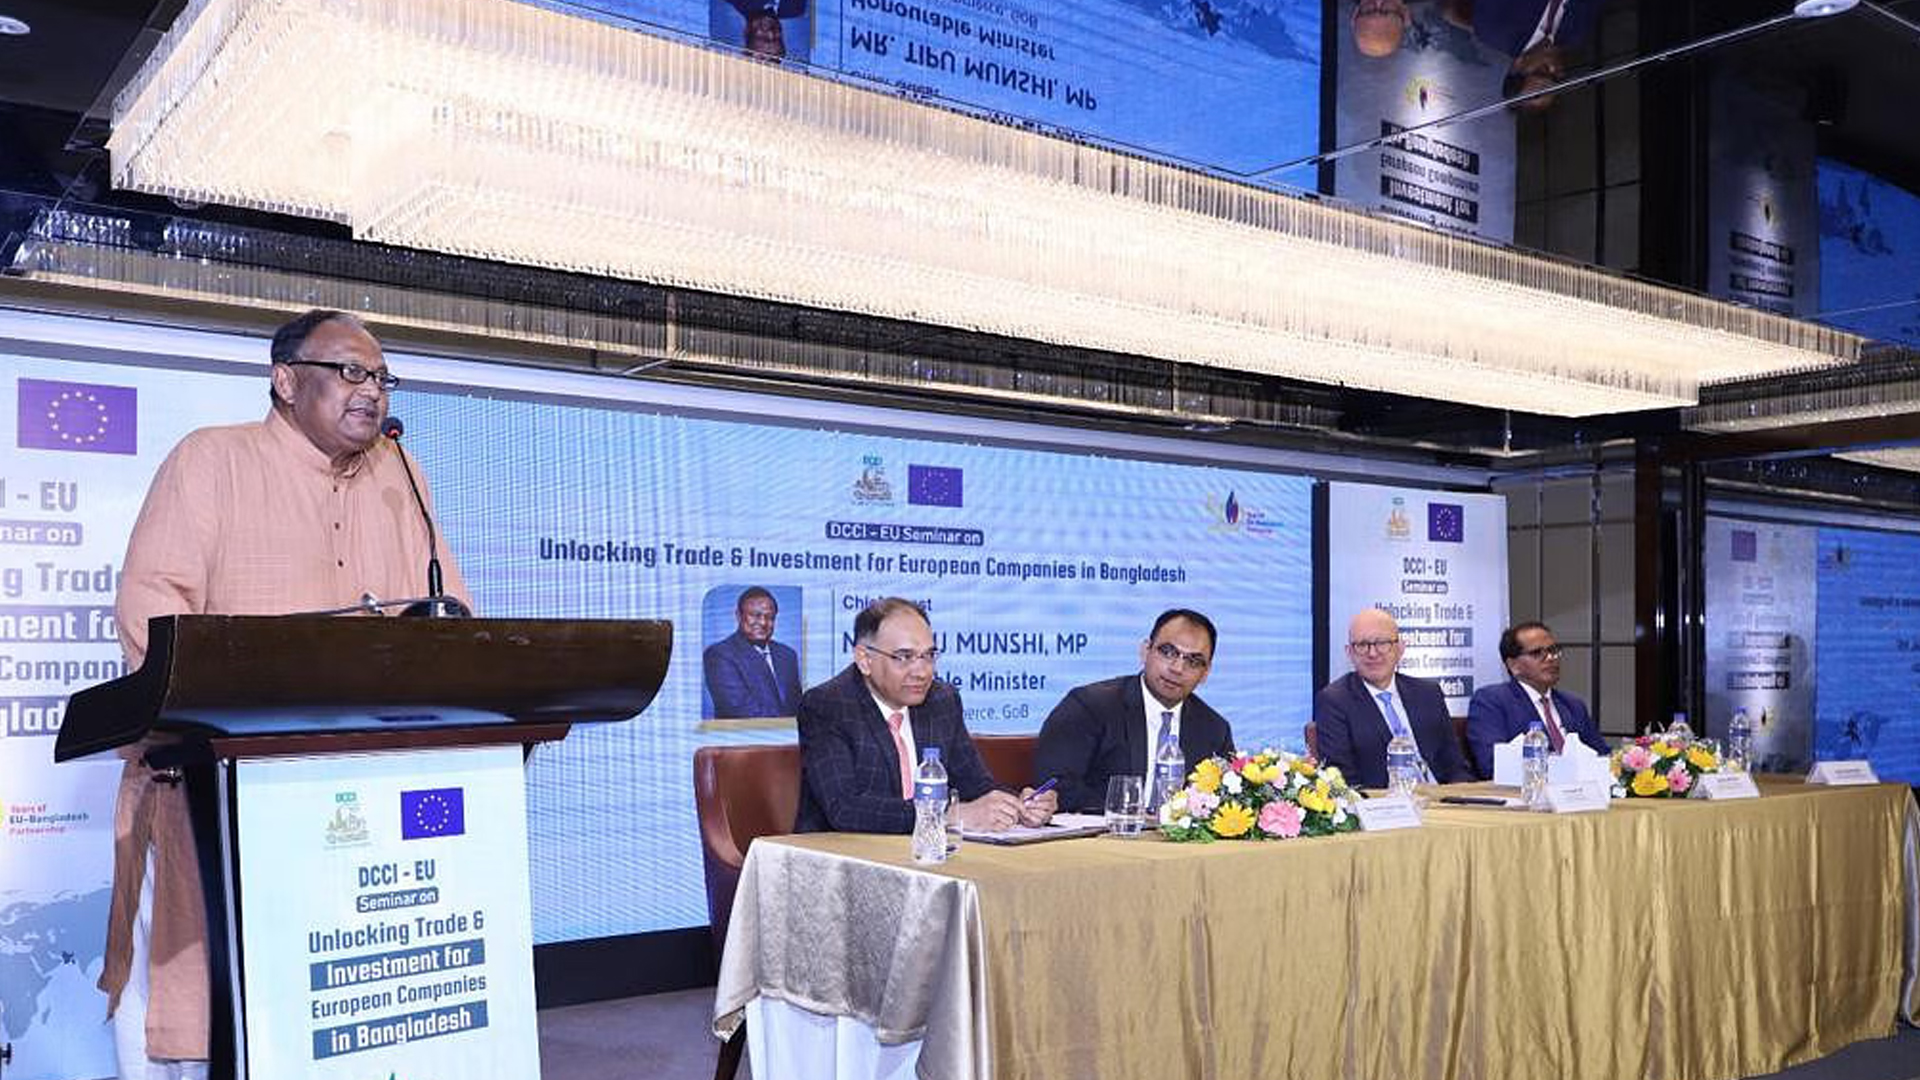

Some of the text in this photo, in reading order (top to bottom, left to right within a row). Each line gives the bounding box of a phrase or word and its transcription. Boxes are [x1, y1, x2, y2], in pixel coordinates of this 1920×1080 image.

[40, 481, 78, 512] EU
[46, 527, 77, 543] on
[830, 524, 867, 539] DCCI
[880, 525, 900, 540] EU
[903, 527, 961, 543] Seminar
[963, 533, 981, 545] on
[540, 538, 1186, 585] Unlocking Trade & Investment for European Companies in Bangladesh
[89, 610, 118, 640] fo
[956, 632, 1049, 657] MUNSHI,
[1057, 633, 1088, 655] MP
[0, 655, 129, 686] Compani
[971, 670, 1046, 691] Minister
[358, 863, 398, 888] DCCI
[415, 859, 435, 881] EU
[360, 890, 436, 911] Seminar on
[309, 910, 484, 954] Unlocking Trade &
[327, 945, 471, 986] Investment for
[312, 975, 487, 1020] European Companies
[331, 1007, 471, 1053] in Bangladesh
